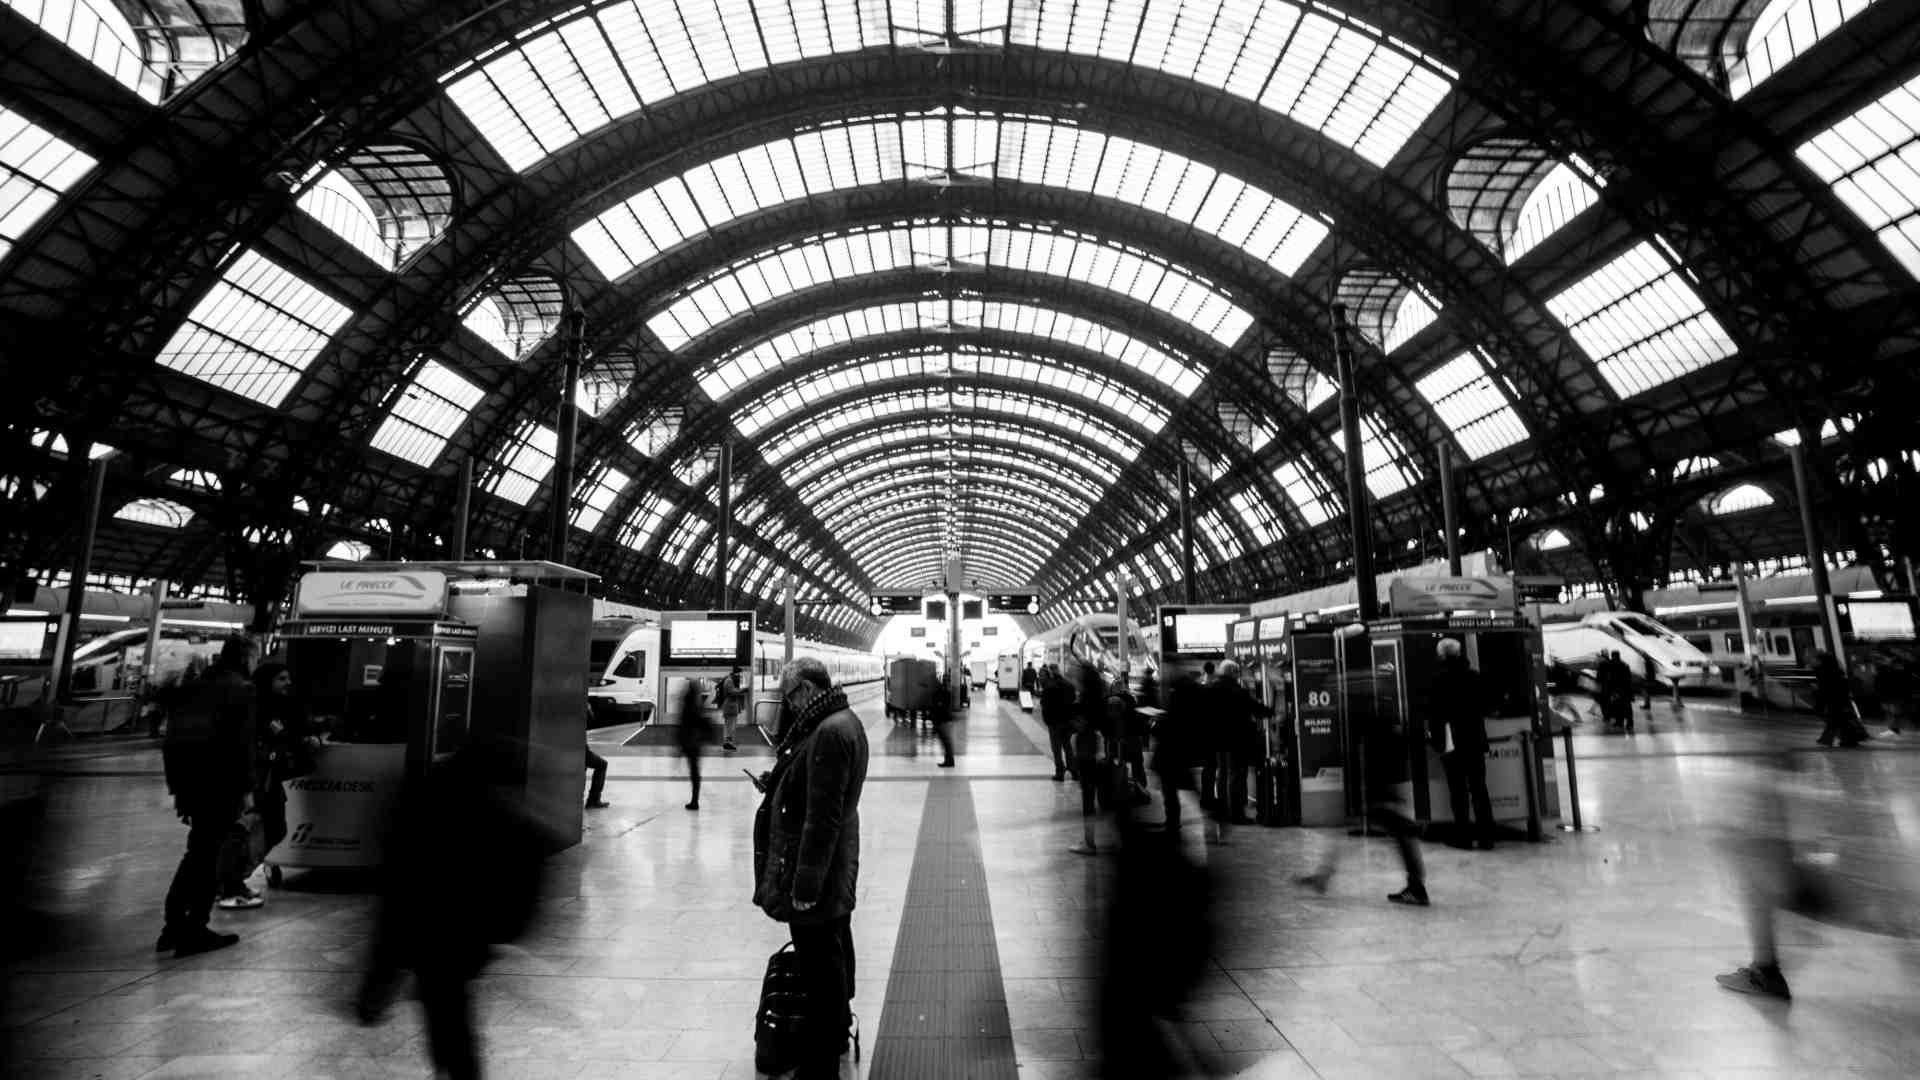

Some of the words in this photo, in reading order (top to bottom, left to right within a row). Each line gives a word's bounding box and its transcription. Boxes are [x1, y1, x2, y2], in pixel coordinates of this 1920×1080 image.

[338, 625, 357, 633] LAST
[358, 625, 393, 635] MINUTE
[1308, 691, 1331, 707] 80
[1304, 718, 1332, 727] MILANO
